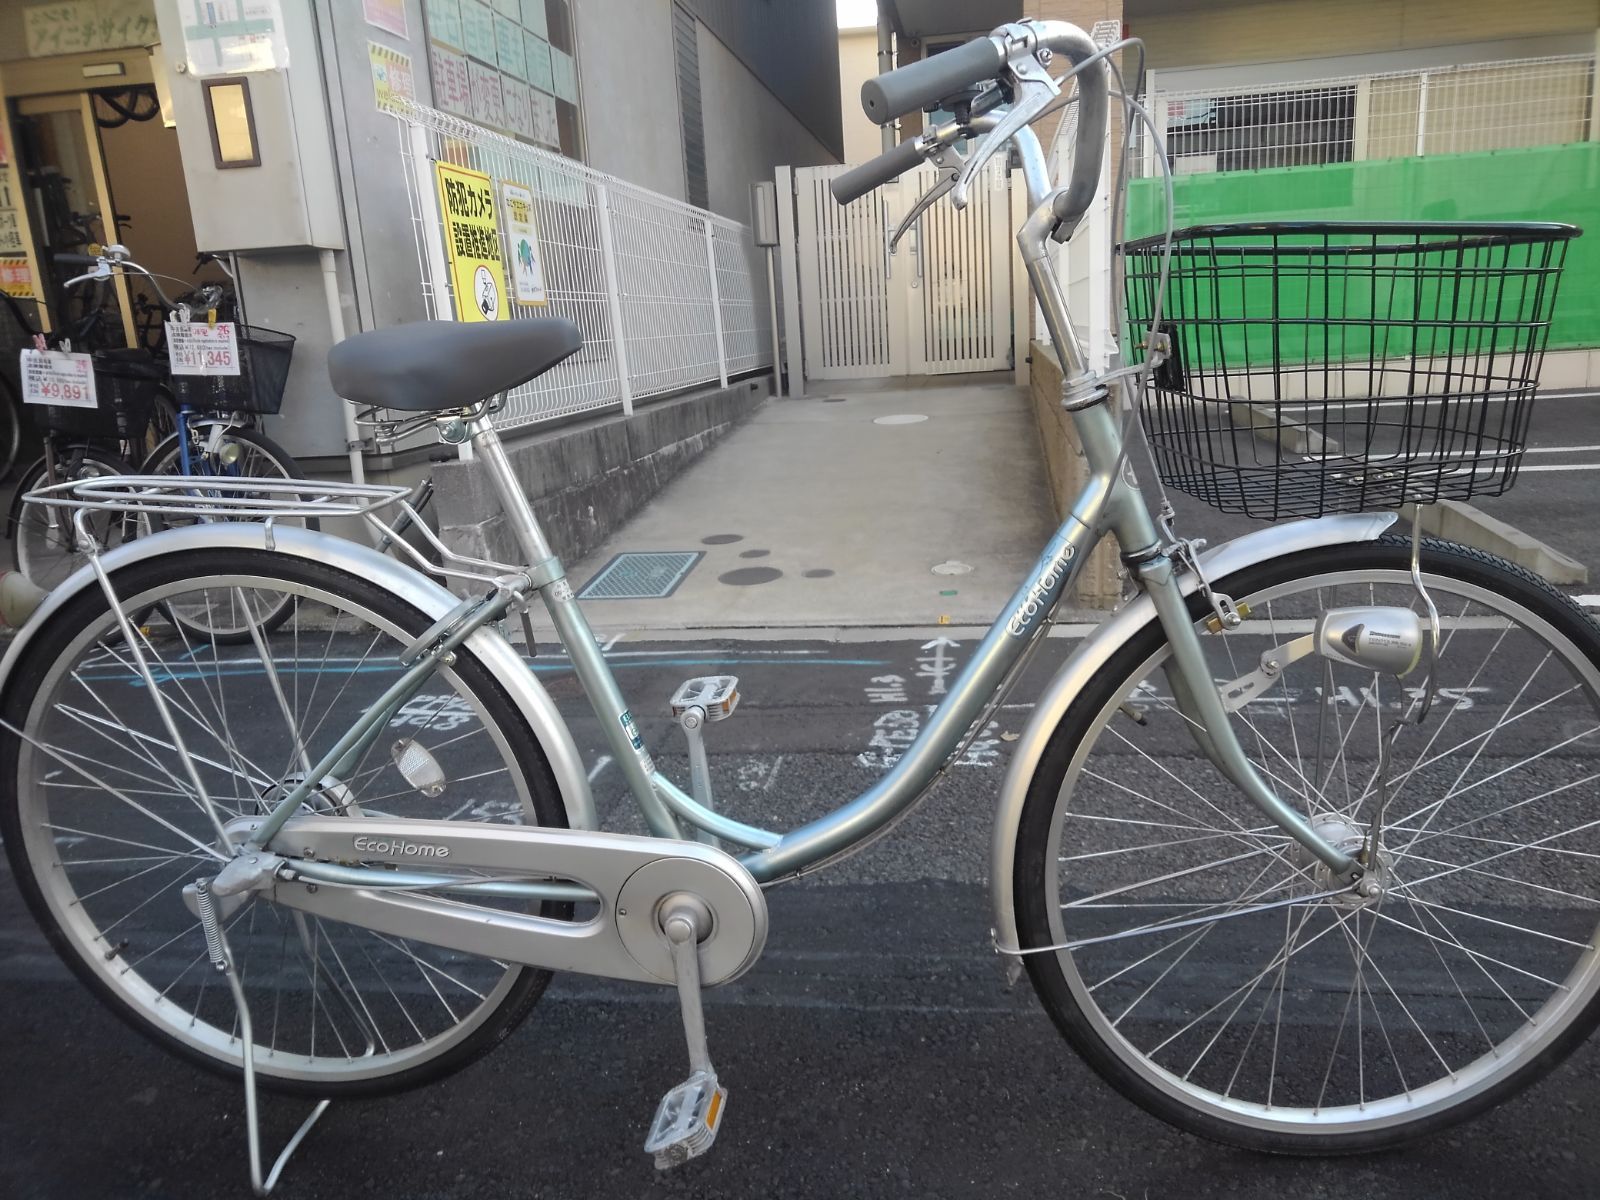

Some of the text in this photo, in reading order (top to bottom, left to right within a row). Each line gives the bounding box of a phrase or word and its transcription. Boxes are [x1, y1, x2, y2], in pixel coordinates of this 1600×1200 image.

[445, 178, 493, 220] 防犯カメラ
[353, 836, 450, 858] EcoHome
